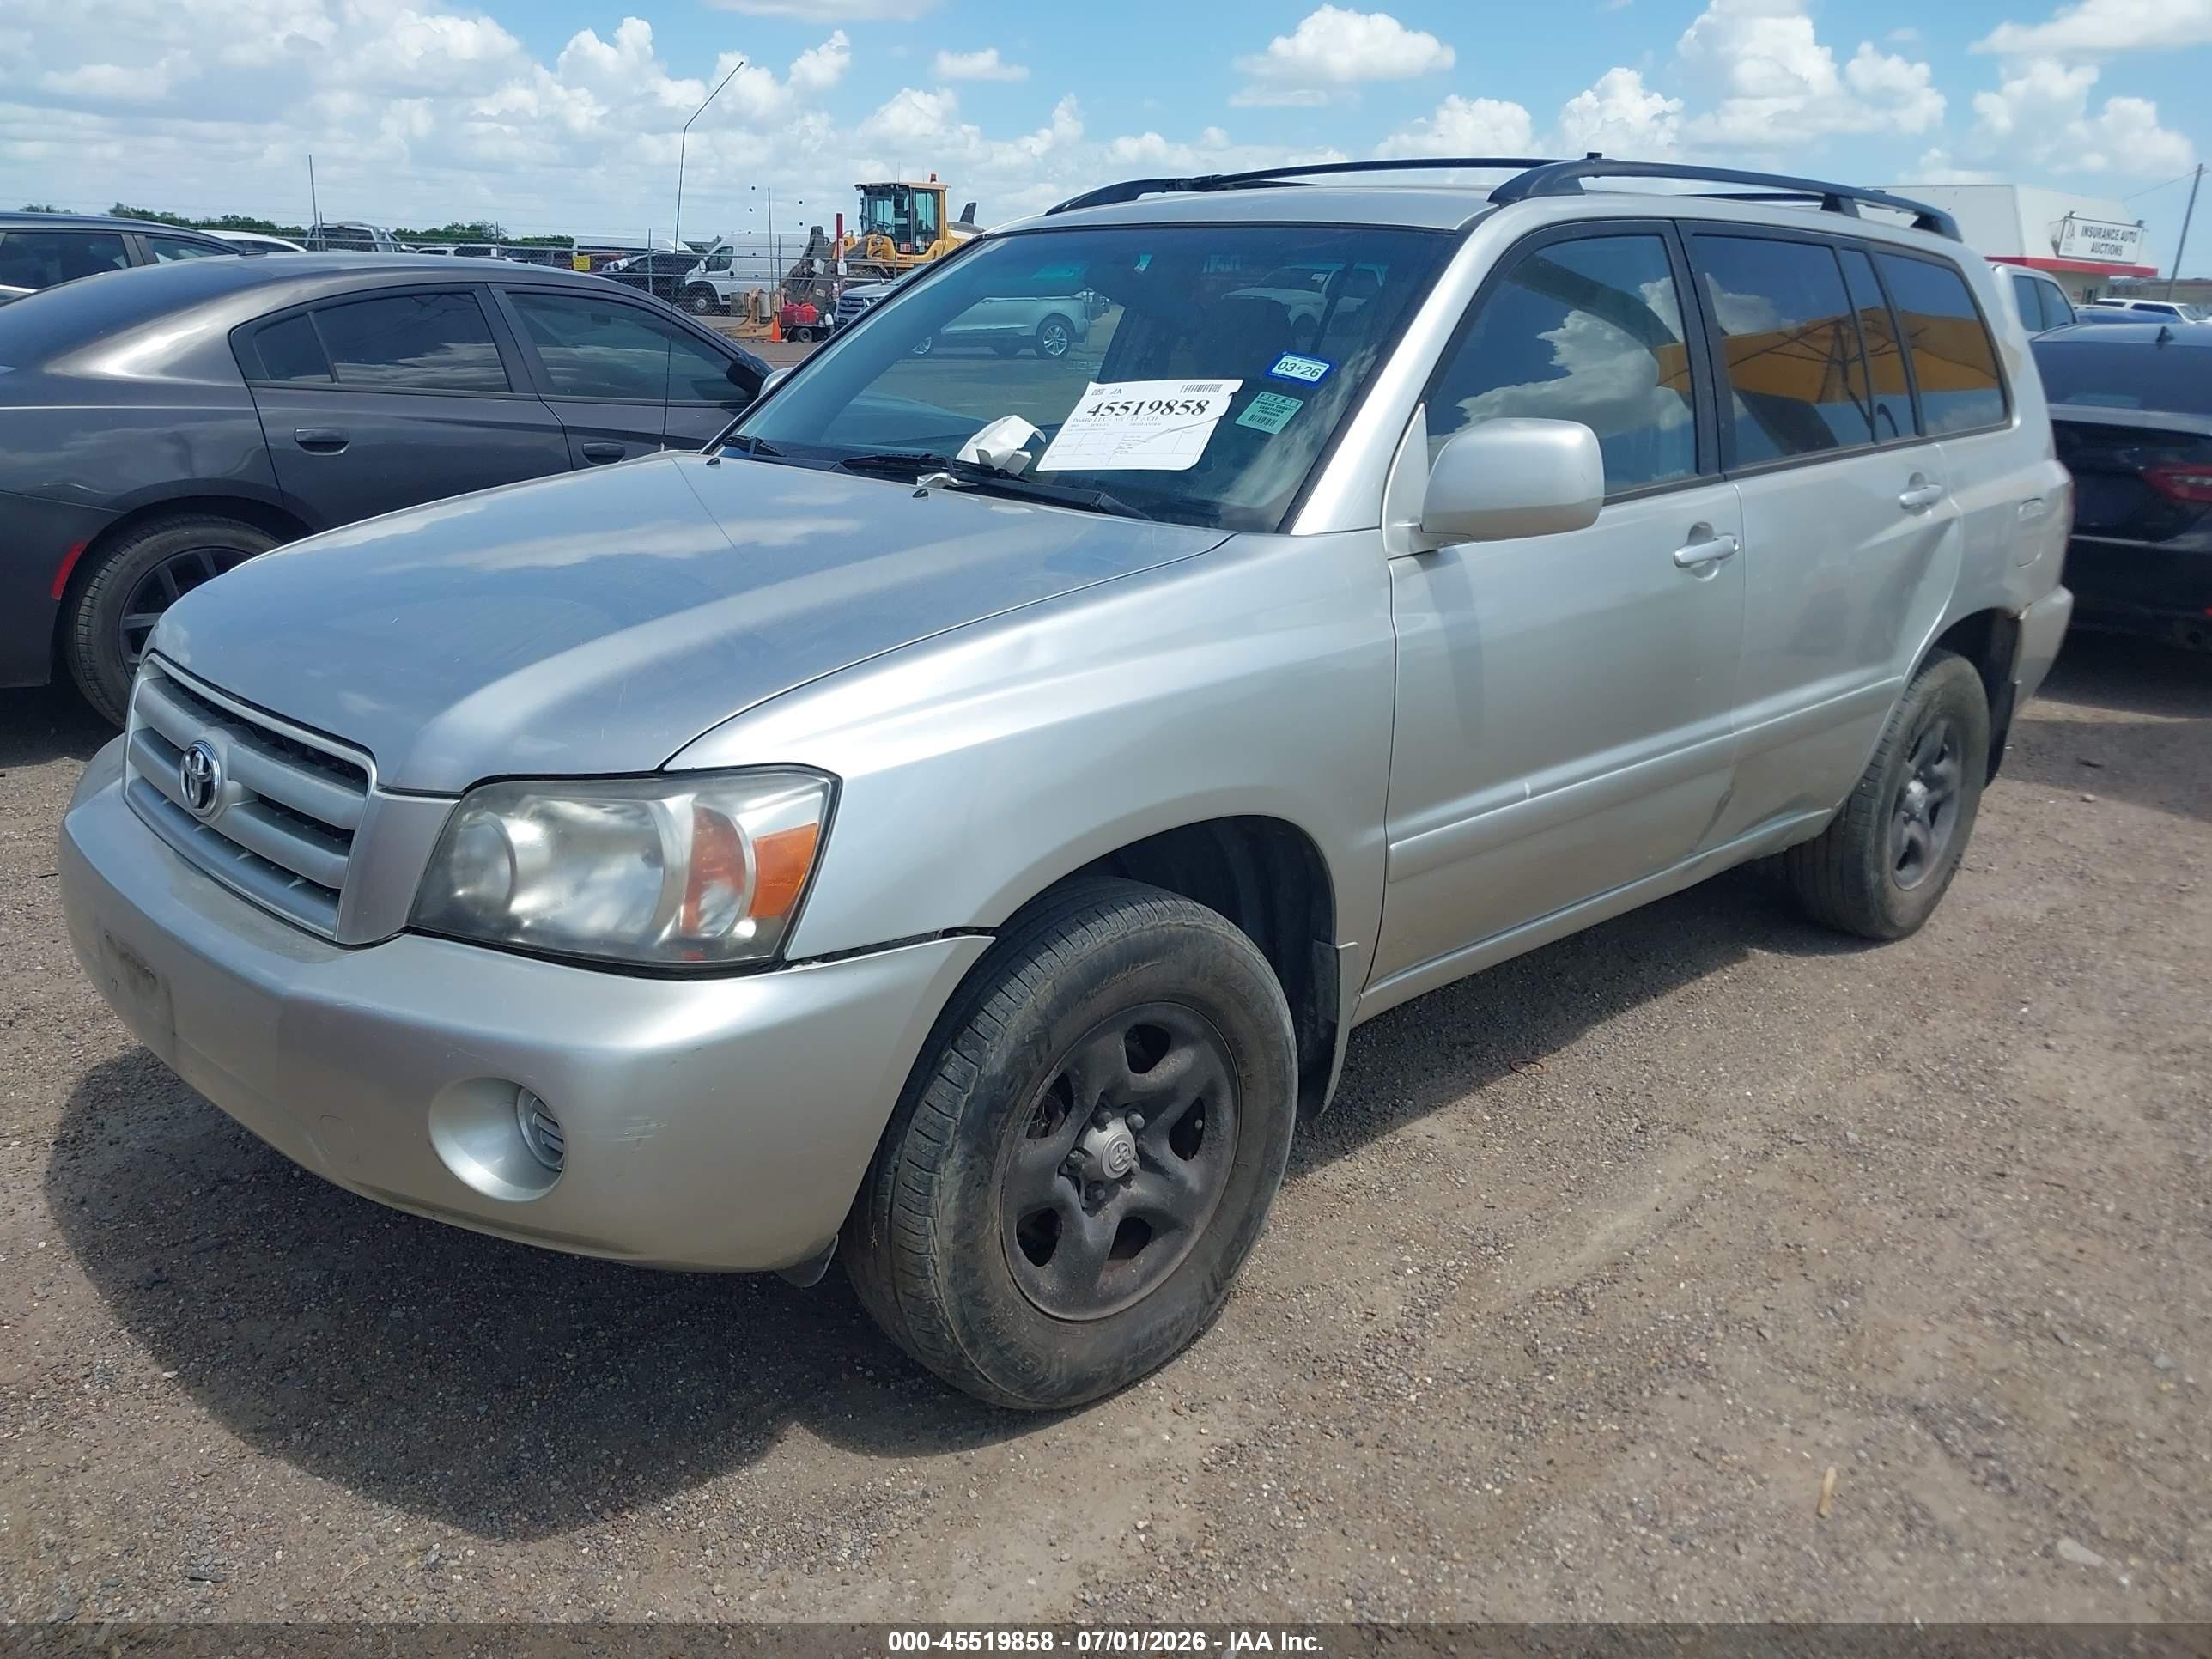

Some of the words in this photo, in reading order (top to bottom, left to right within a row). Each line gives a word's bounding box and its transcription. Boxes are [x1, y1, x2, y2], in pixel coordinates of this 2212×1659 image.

[2081, 225, 2120, 240] INSURANCE
[2120, 229, 2137, 243] AUTO
[2090, 242, 2123, 256] AUCTIONS
[1277, 361, 1297, 372] 03
[1300, 366, 1322, 378] 26
[1086, 398, 1211, 417] 45519858
